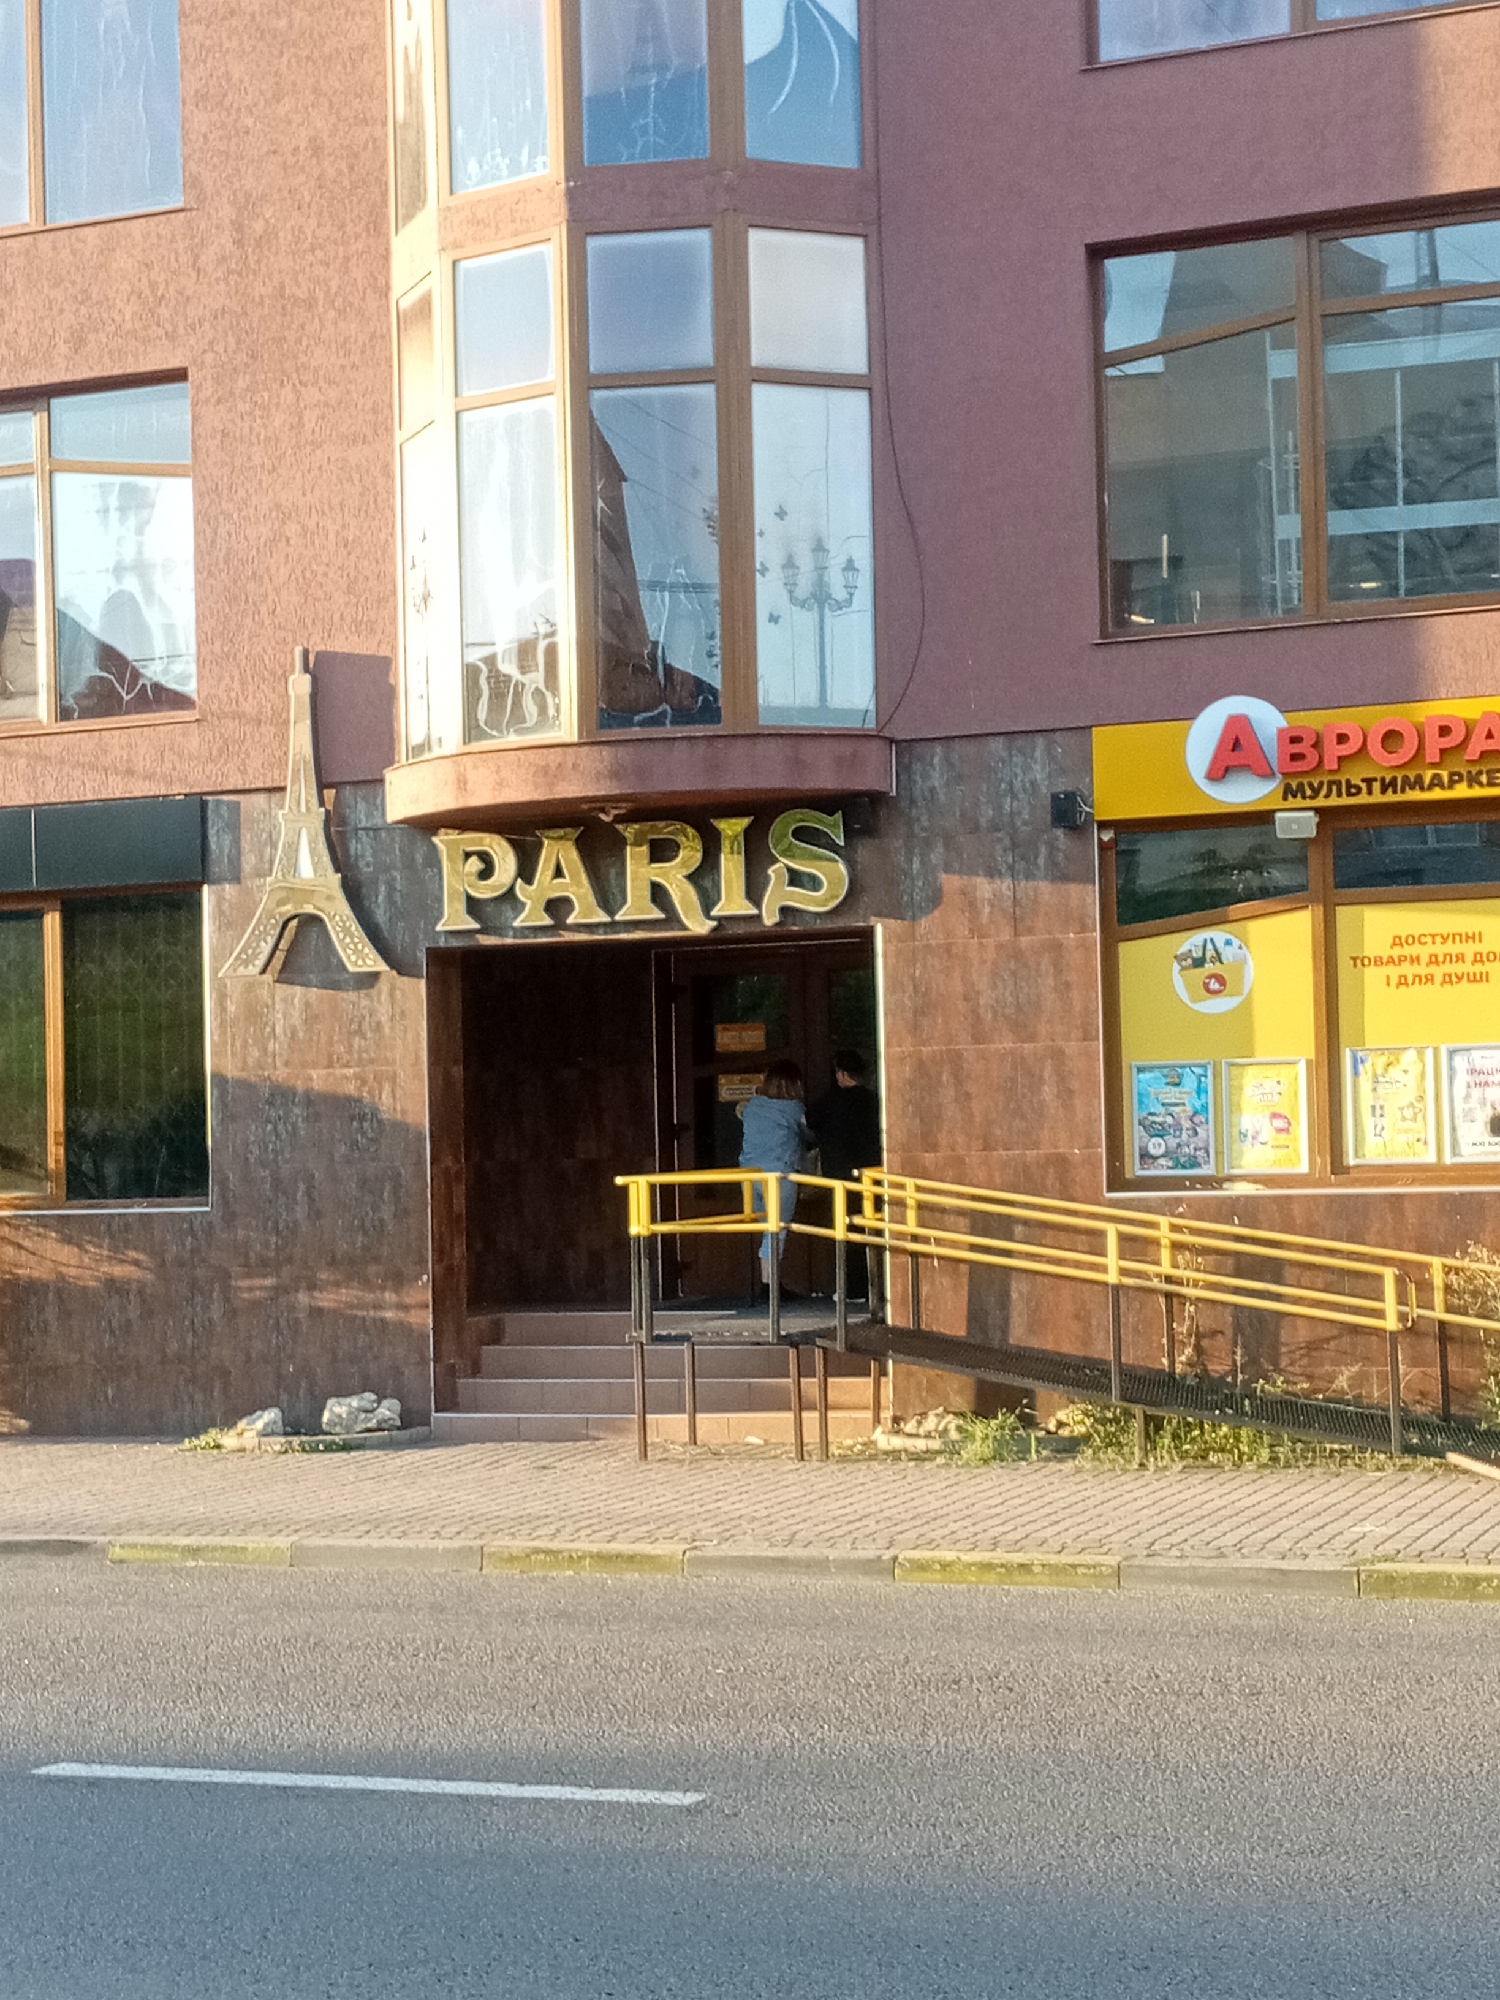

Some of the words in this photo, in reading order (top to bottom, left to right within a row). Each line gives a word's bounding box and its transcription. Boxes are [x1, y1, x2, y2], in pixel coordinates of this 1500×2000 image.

[1205, 711, 1500, 780] АВРОРА
[431, 808, 850, 934] PARIS
[1390, 931, 1483, 949] ДОСТУПНІ
[1350, 953, 1421, 969] ТОВАРИ
[1426, 952, 1465, 967] ДЛЯ
[1471, 950, 1500, 966] ДО
[1385, 974, 1391, 987] І
[1396, 973, 1435, 990] ДЛЯ
[1440, 971, 1490, 987] ДУШІ
